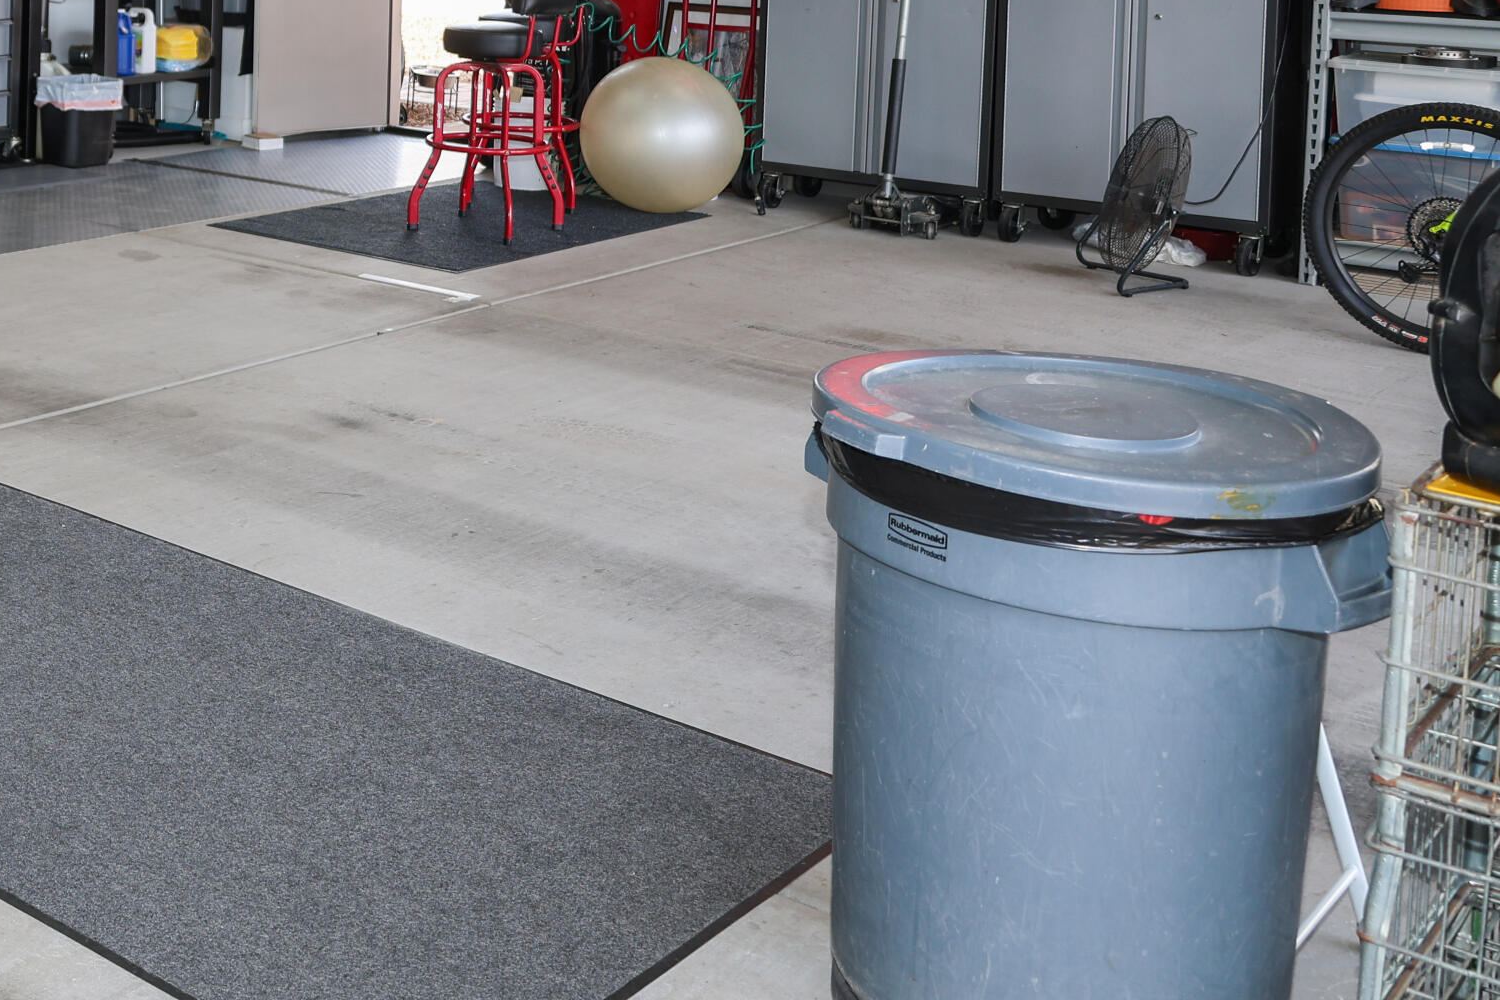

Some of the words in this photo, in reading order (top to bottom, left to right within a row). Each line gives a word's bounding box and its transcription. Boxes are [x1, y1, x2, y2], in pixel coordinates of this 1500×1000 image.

[1420, 115, 1495, 129] MAXXIS
[890, 517, 945, 545] Rubbermaid
[887, 533, 919, 553] Commercial
[920, 546, 947, 562] Products
